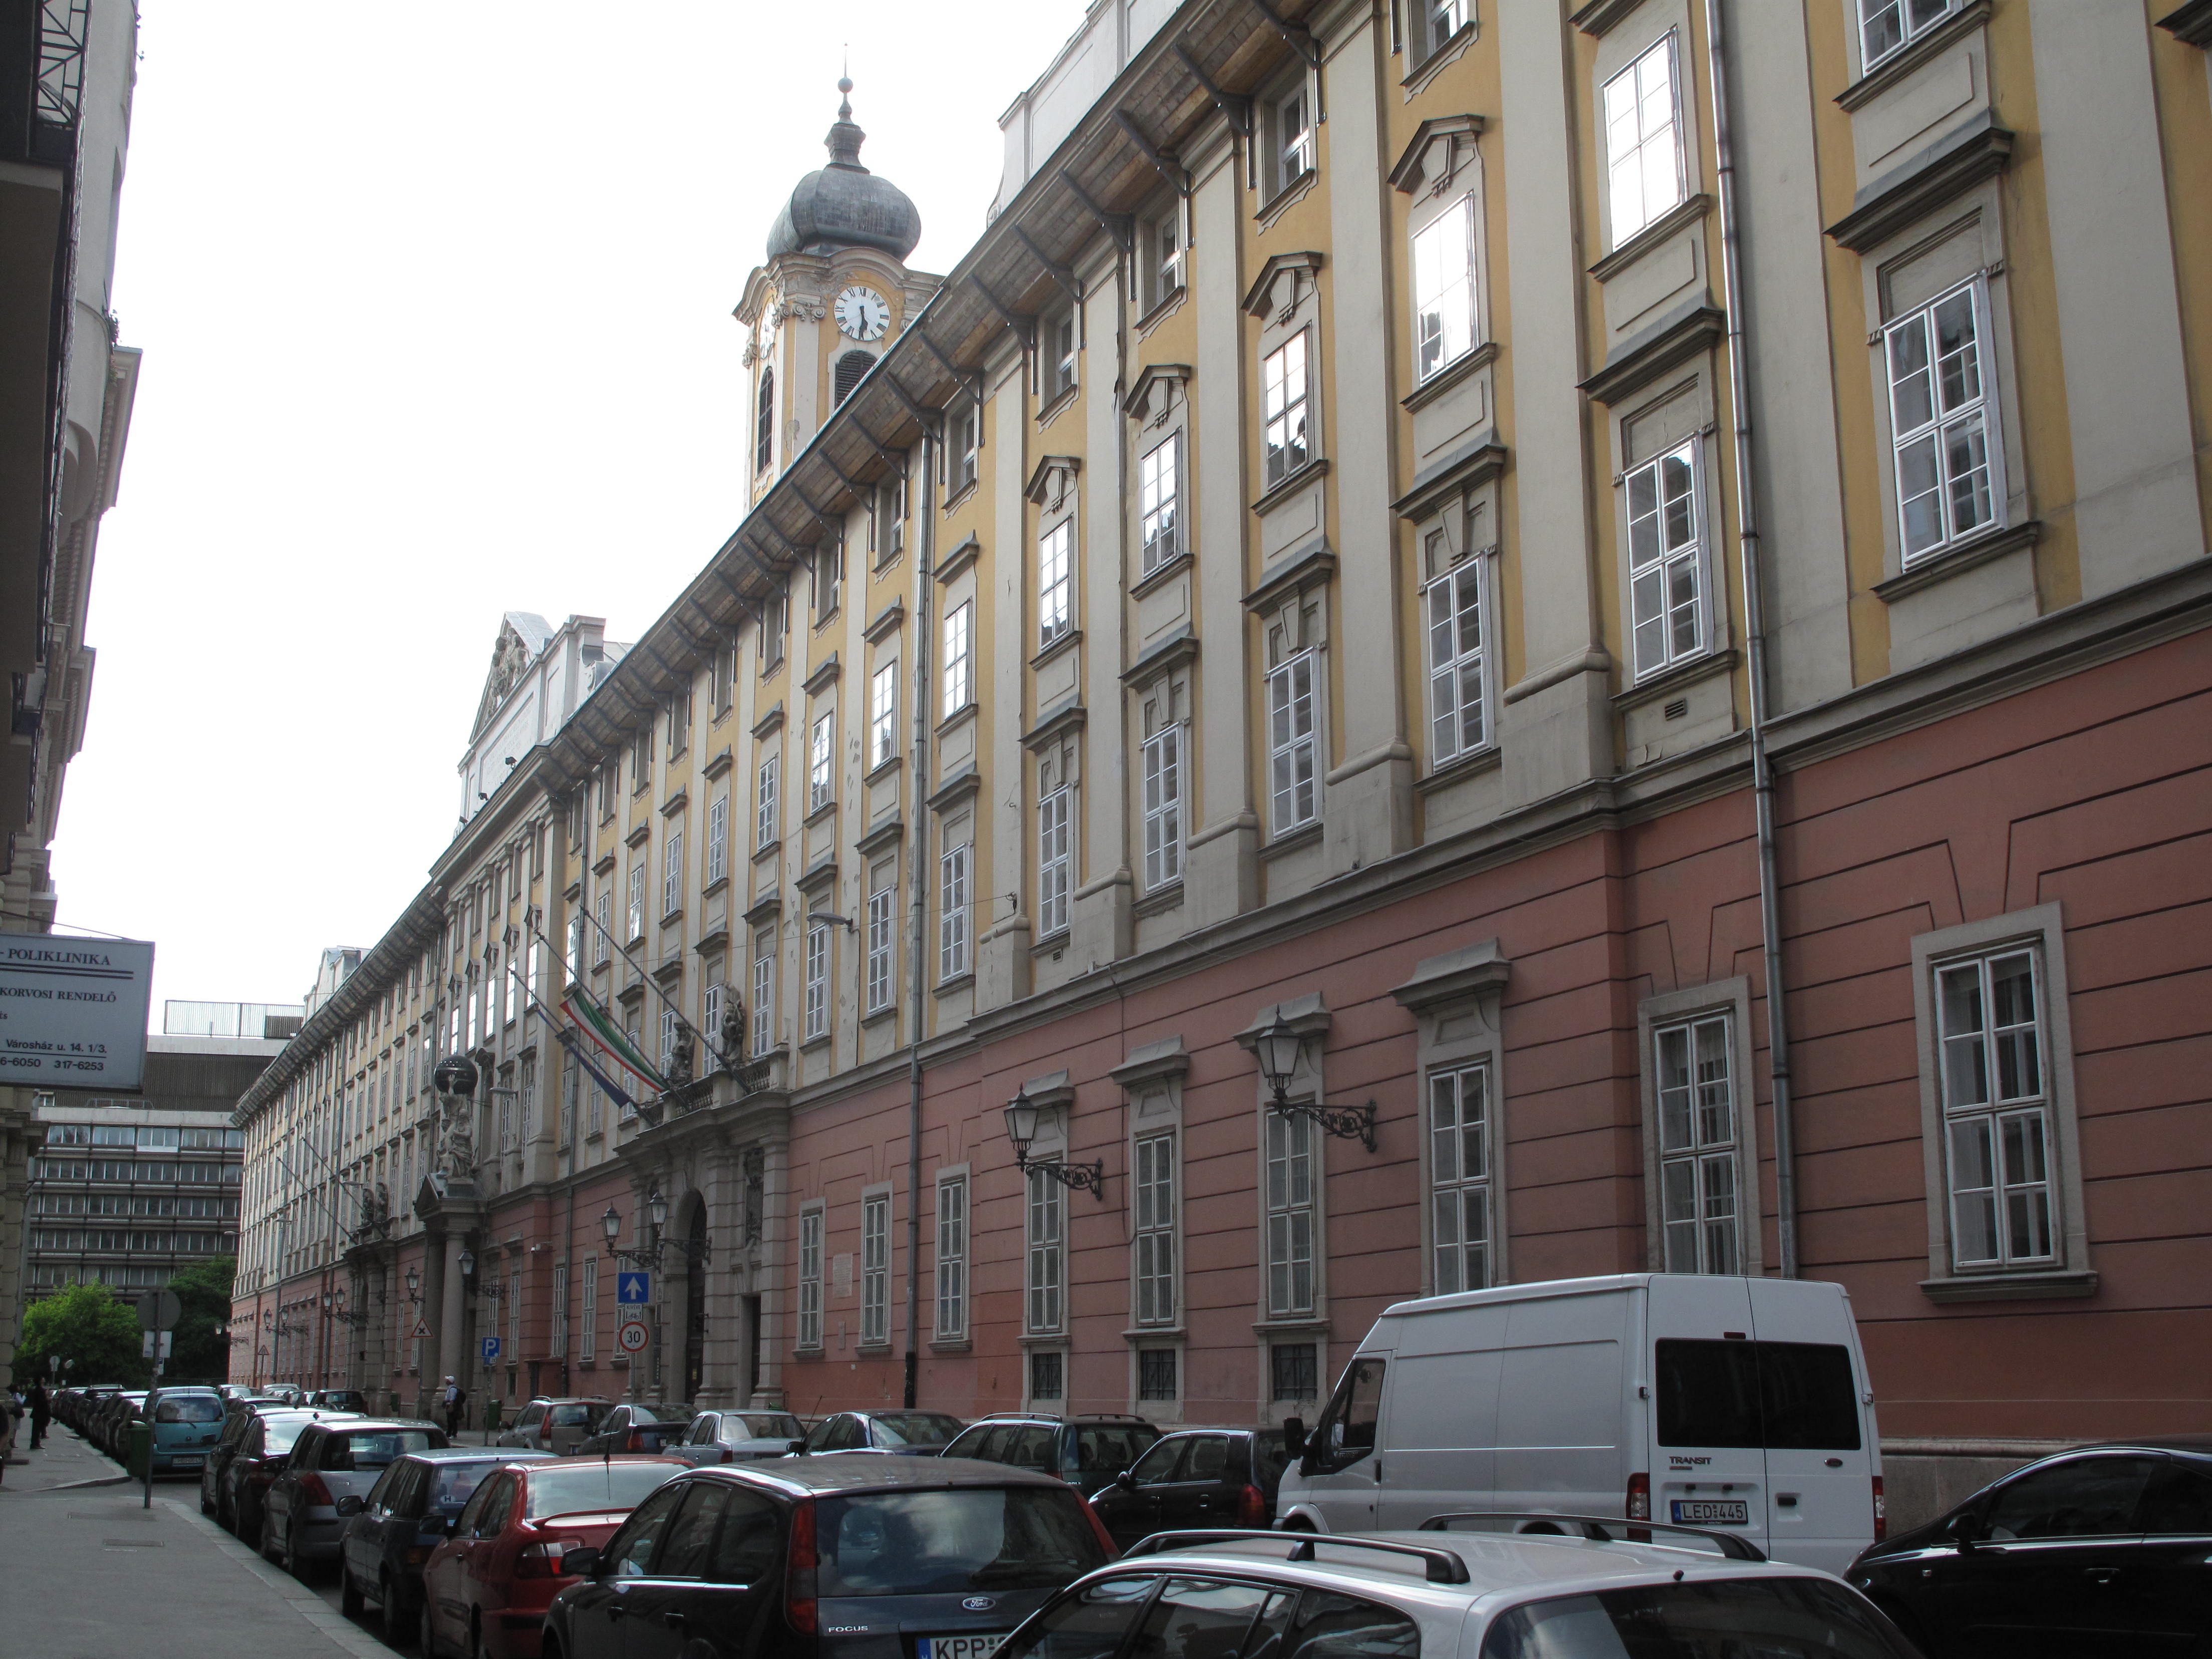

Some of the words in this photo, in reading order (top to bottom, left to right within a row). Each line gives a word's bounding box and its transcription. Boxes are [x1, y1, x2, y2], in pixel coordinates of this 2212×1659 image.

[8, 948, 111, 965] POLIKLINIKA
[0, 987, 53, 999] KORVOSI
[58, 991, 116, 1003] RENDELŐ
[7, 1039, 53, 1050] Városház
[71, 1043, 84, 1052] 14.
[89, 1044, 107, 1053] 1/3.
[0, 1057, 41, 1068] 6-6050
[54, 1060, 104, 1071] 317-6253
[627, 1331, 640, 1343] 30
[485, 1339, 496, 1355] P
[1669, 1456, 1712, 1465] TRANSIT
[970, 1598, 988, 1607] Ford
[828, 1625, 869, 1633] FOCUS
